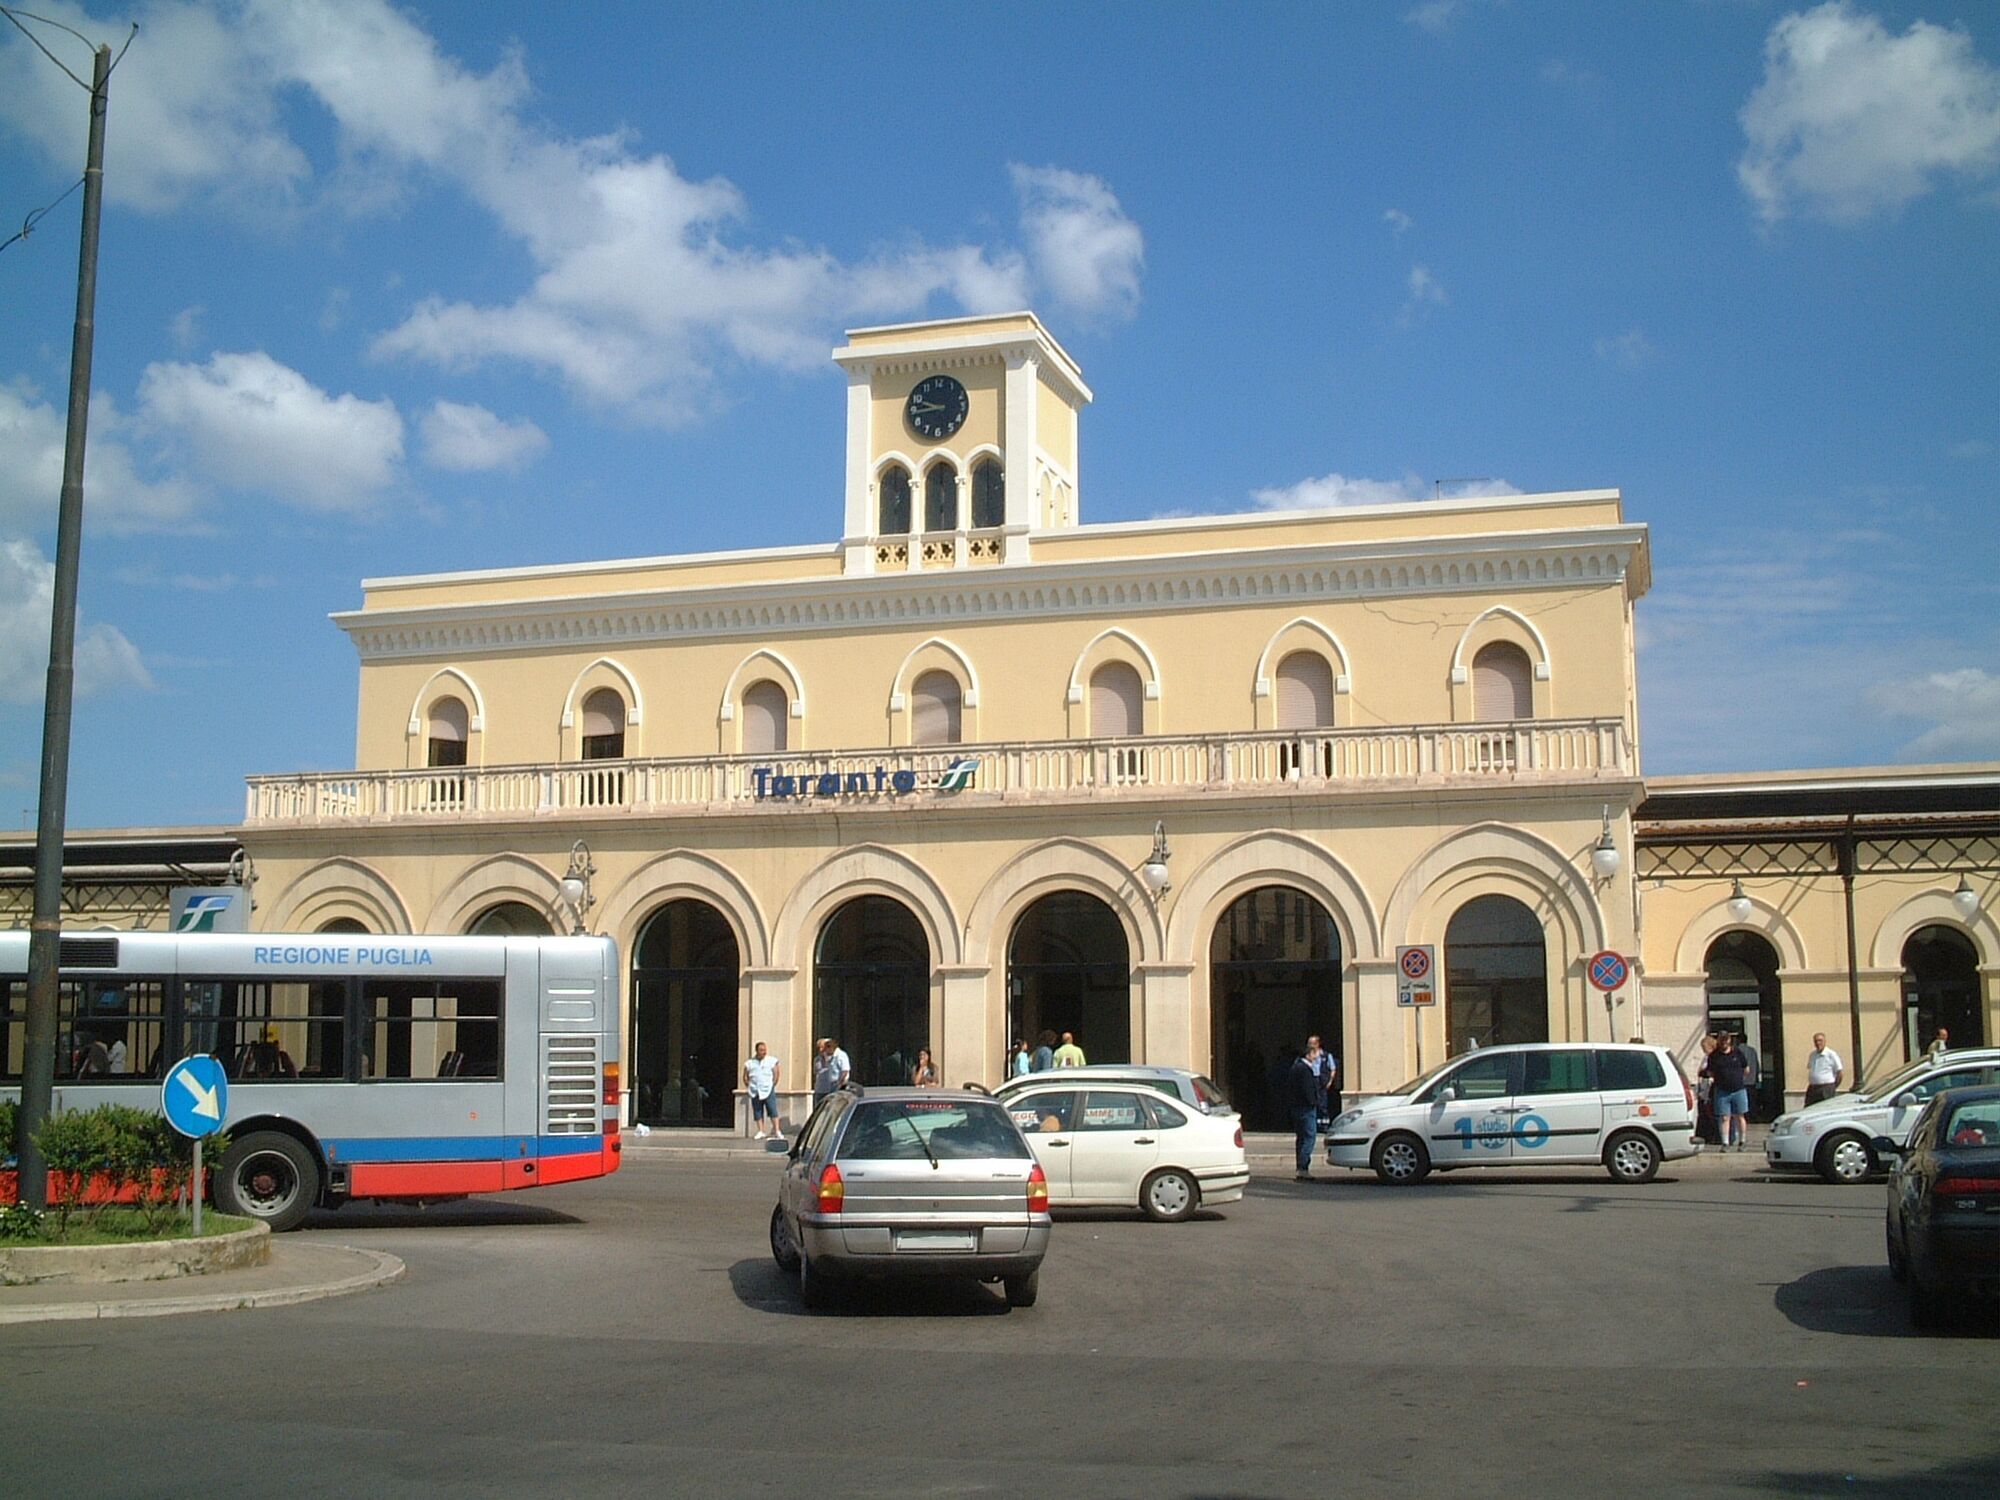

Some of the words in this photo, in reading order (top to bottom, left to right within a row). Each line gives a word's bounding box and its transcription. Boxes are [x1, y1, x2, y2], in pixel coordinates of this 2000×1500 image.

[923, 383, 930, 393] 11
[935, 379, 944, 388] 12
[913, 394, 923, 404] 10
[955, 413, 962, 422] 4
[923, 425, 930, 435] 7
[934, 427, 942, 437] 6
[947, 422, 955, 432] 5
[753, 766, 915, 799] Taranto
[254, 947, 349, 964] REGIONE
[357, 948, 433, 965] PUGLIA
[1478, 1117, 1508, 1132] studio
